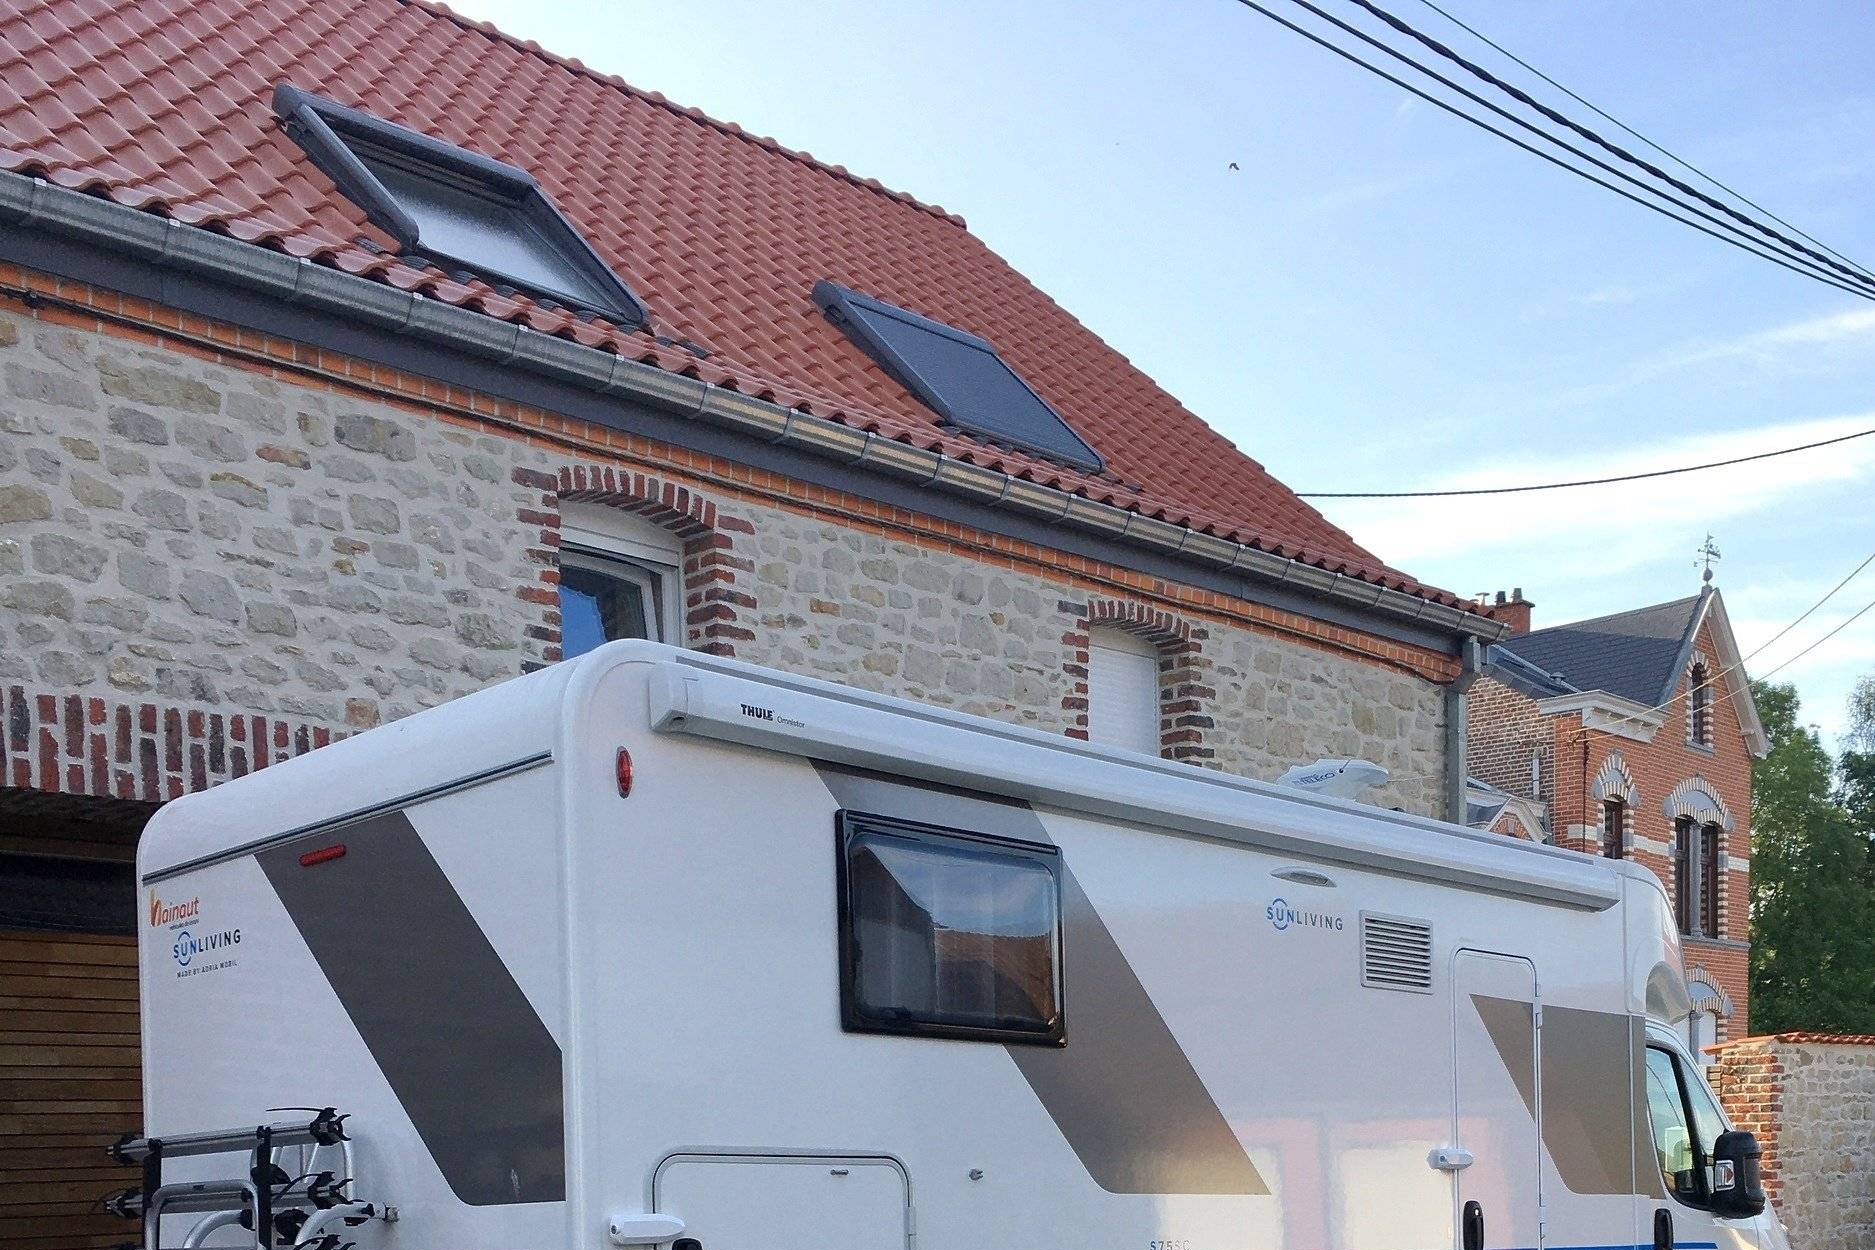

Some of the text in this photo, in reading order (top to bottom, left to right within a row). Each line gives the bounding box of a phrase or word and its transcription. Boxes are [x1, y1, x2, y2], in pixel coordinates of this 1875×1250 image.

[740, 703, 774, 721] THULE
[1266, 903, 1343, 931] SUNLIVING
[173, 928, 241, 961] SUNLIVING
[177, 970, 191, 978] MADE
[193, 968, 201, 976] BY
[202, 963, 218, 973] ADRIA
